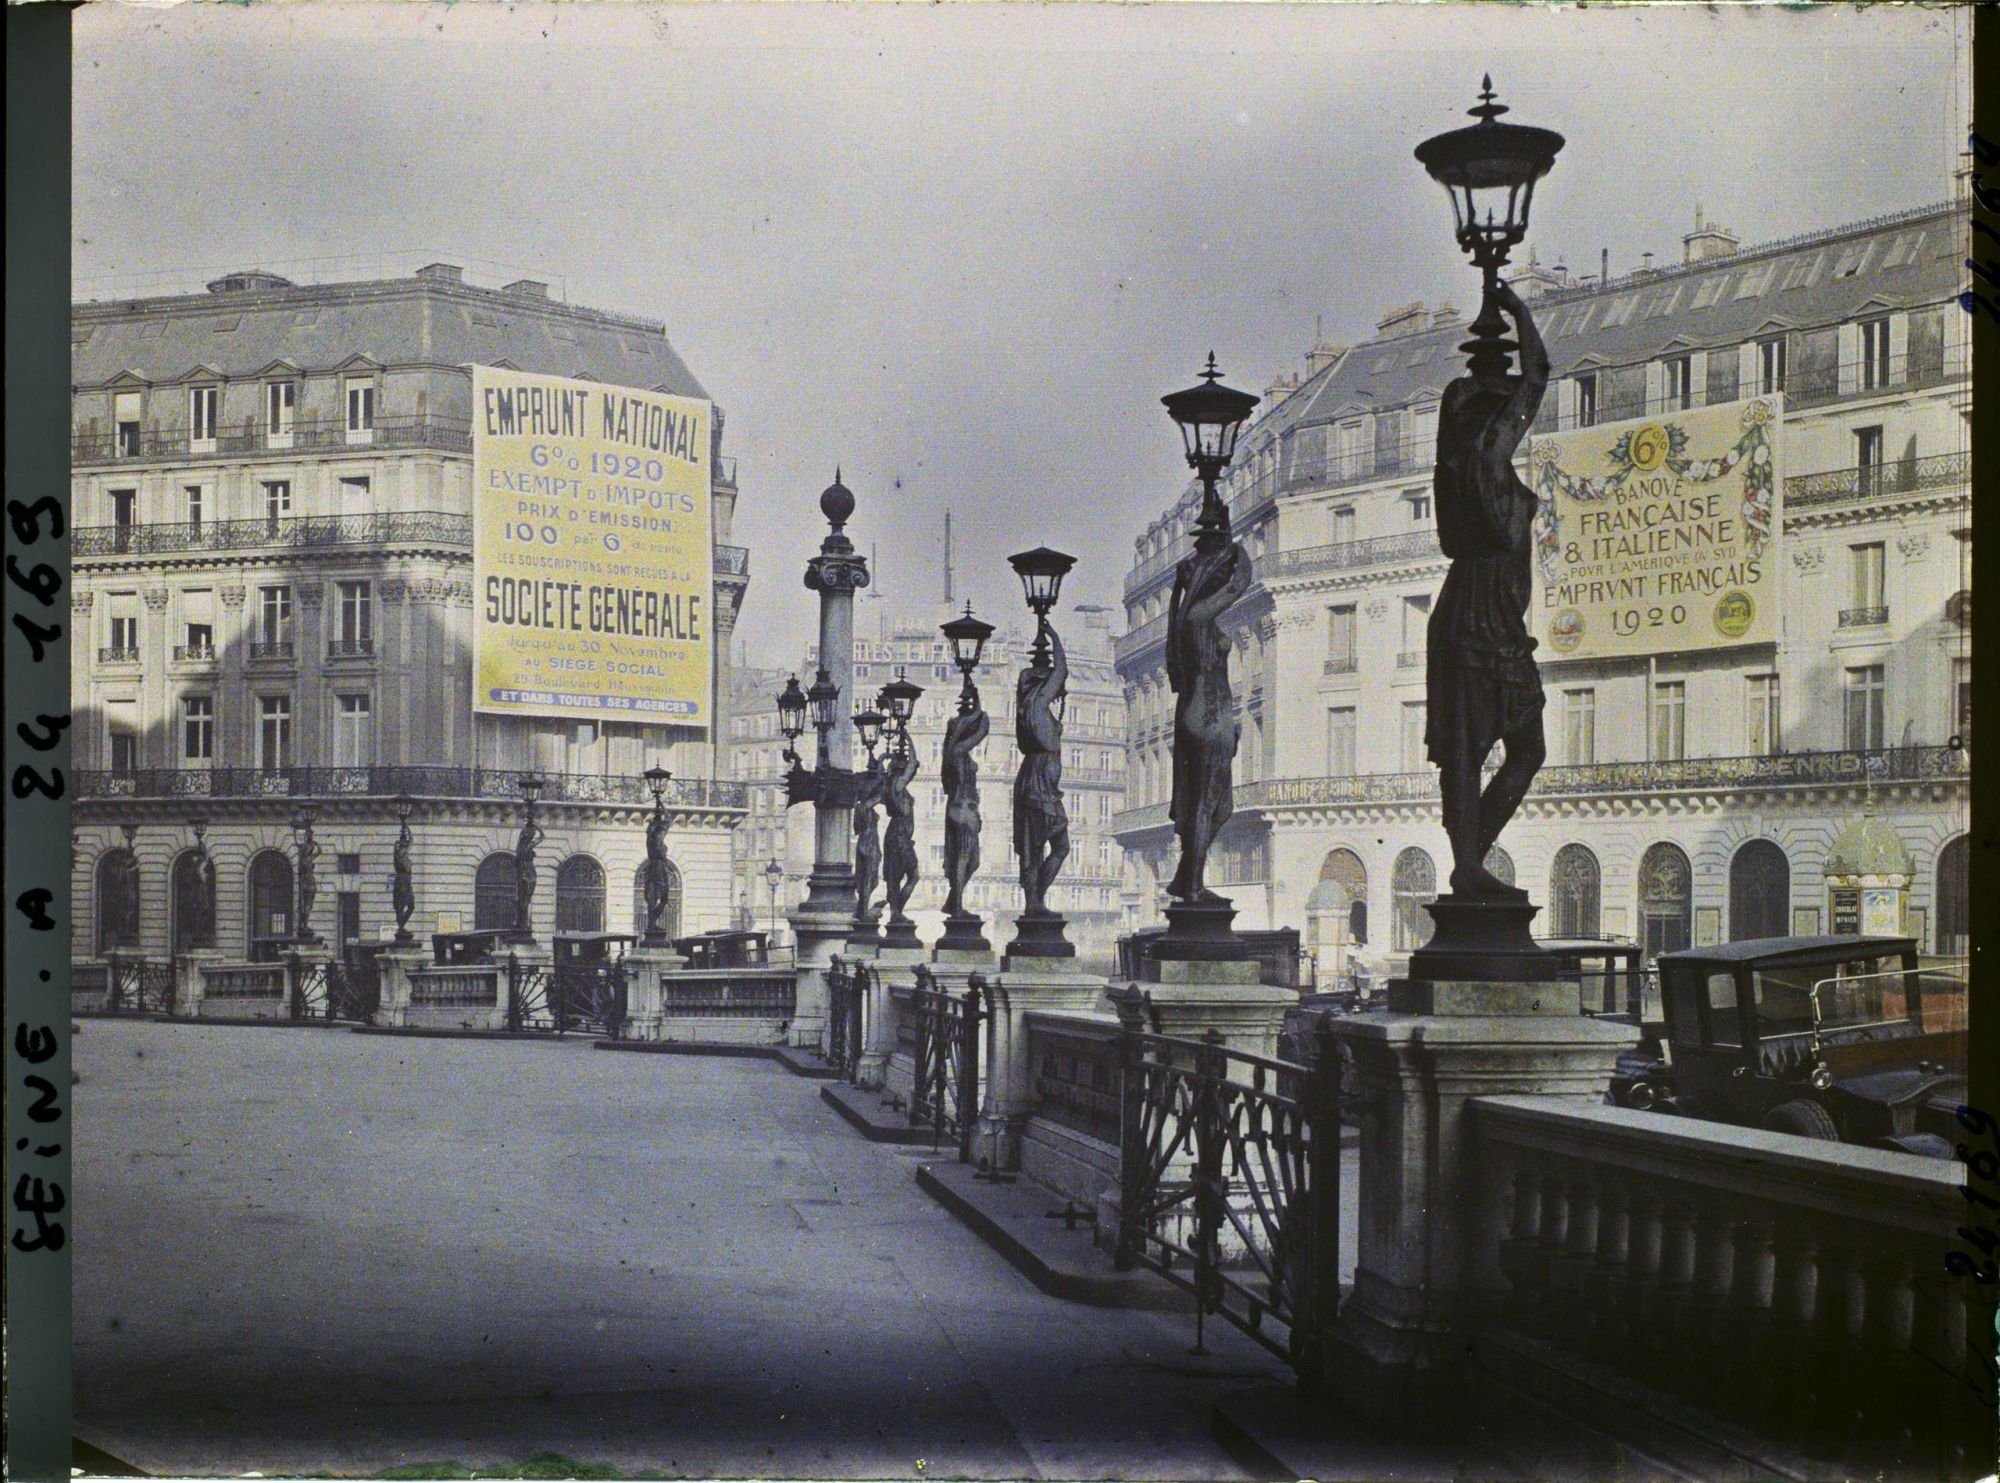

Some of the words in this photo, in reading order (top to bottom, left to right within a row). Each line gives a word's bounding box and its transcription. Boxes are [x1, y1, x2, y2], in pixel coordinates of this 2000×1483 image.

[484, 386, 589, 438] EMPRUNT
[602, 392, 699, 463] NATIONAL
[1632, 427, 1668, 465] 6%
[591, 452, 664, 482] 1920
[489, 469, 582, 499] EXEMPT
[518, 501, 560, 519] PRIX
[1581, 495, 1721, 535] FRANÇAISE
[1565, 542, 1583, 563] &
[1593, 519, 1734, 561] ITALIENNE
[5, 494, 65, 662] 169
[498, 553, 514, 565] LES
[518, 555, 602, 573] SOUSCRIPTIONS
[607, 564, 632, 576] SONT
[1658, 561, 1762, 596] FRANÇAIS
[486, 575, 582, 631] SOCIÉTÉ
[589, 583, 701, 641] GÉNÉRALE
[1612, 605, 1687, 637] 1920
[580, 639, 601, 655] 30
[611, 642, 686, 661] Novembre
[806, 641, 892, 661] GRIES
[525, 658, 541, 668] AU
[606, 661, 665, 677] SOCIAL
[501, 690, 518, 701] ET
[521, 691, 554, 705] DANS
[558, 694, 601, 708] TOUTES
[607, 697, 630, 709] SES
[635, 699, 689, 714] AGENCES
[10, 713, 71, 800] 24
